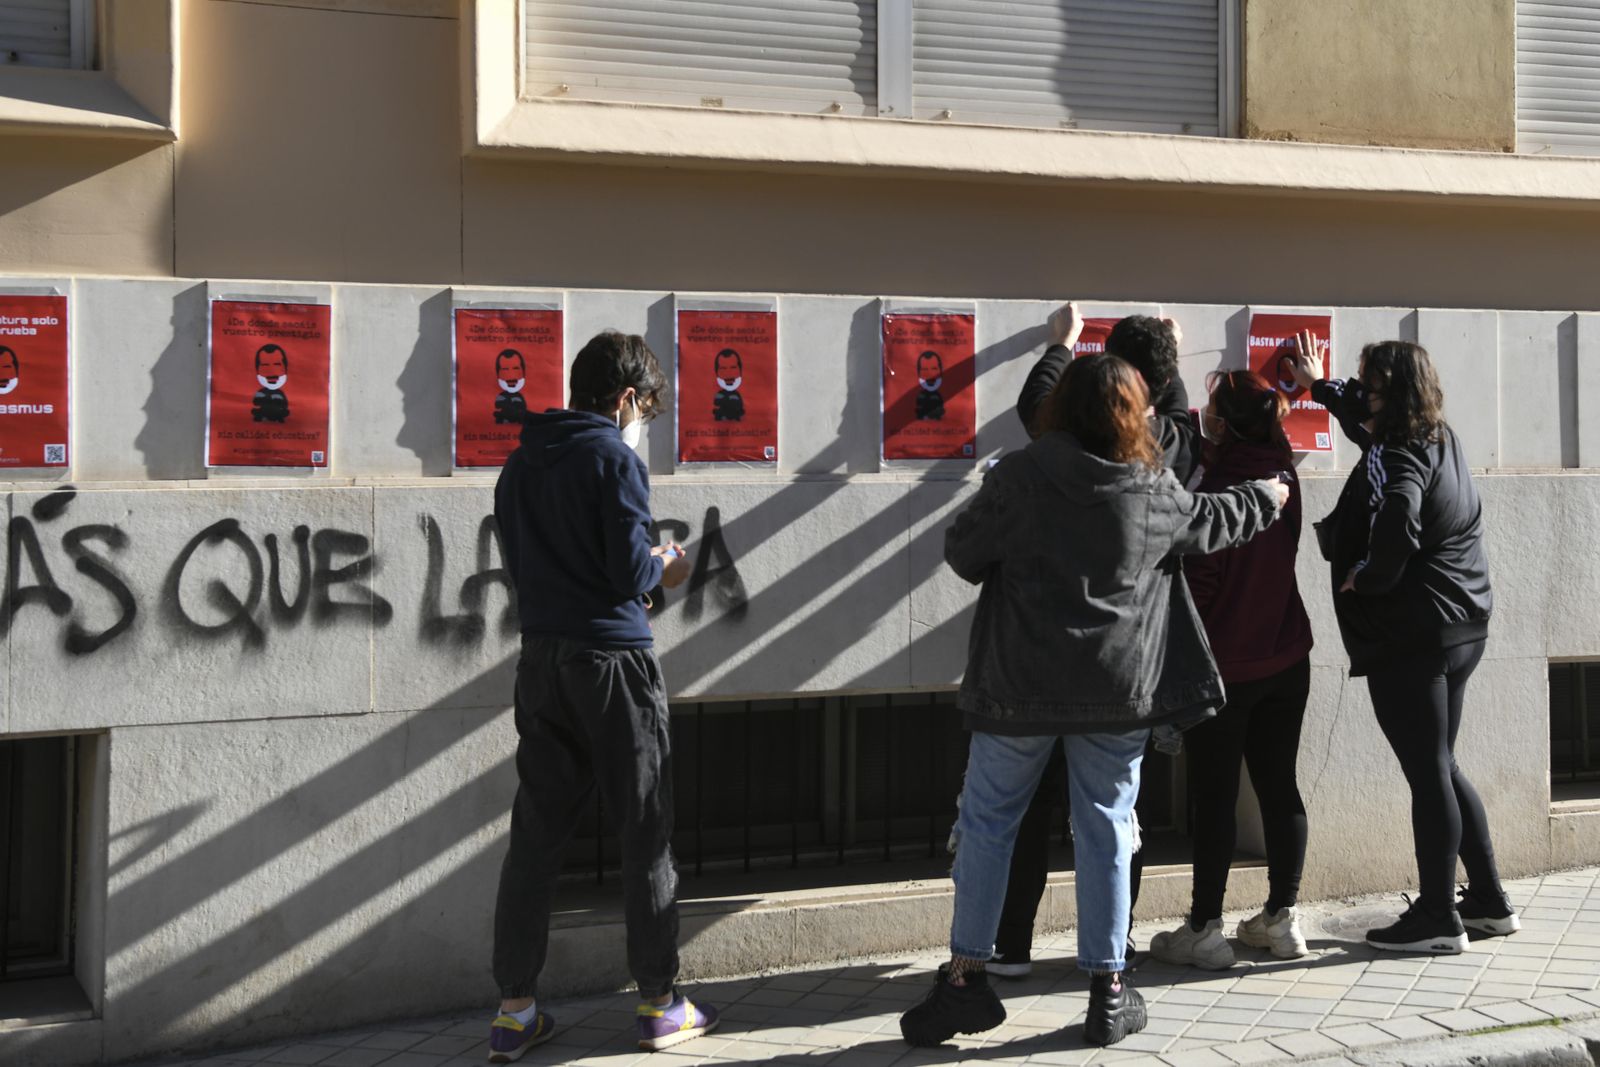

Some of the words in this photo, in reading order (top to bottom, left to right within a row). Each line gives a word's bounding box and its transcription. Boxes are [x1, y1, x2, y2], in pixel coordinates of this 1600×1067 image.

[32, 316, 58, 325] solo
[1075, 341, 1102, 353] BASTA
[1250, 335, 1274, 347] BASTA
[158, 517, 394, 652] QUE
